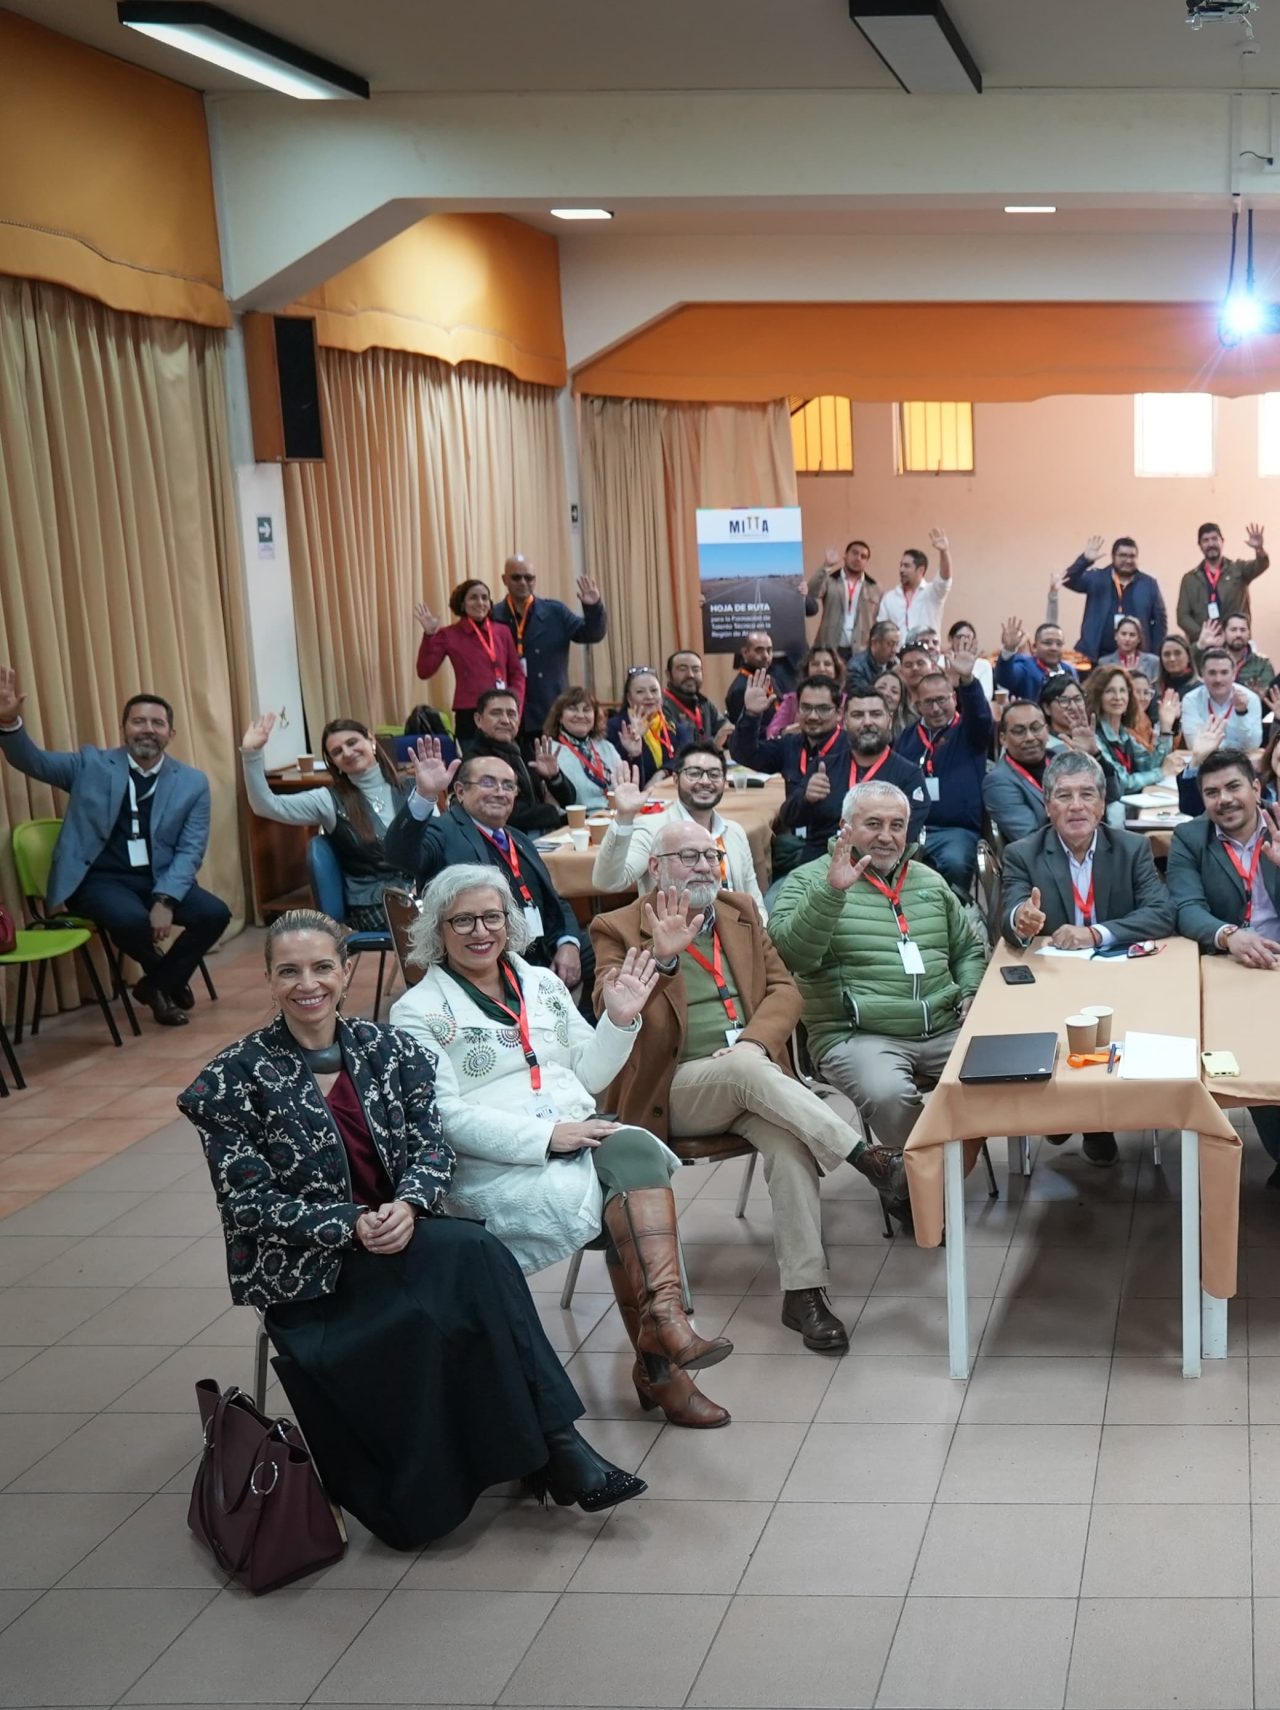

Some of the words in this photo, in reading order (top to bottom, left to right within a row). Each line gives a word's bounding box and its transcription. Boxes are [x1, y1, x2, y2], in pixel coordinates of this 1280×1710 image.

[729, 516, 769, 533] MITTA
[710, 604, 733, 613] HOJA
[734, 603, 746, 612] DE
[747, 603, 770, 612] RUTA
